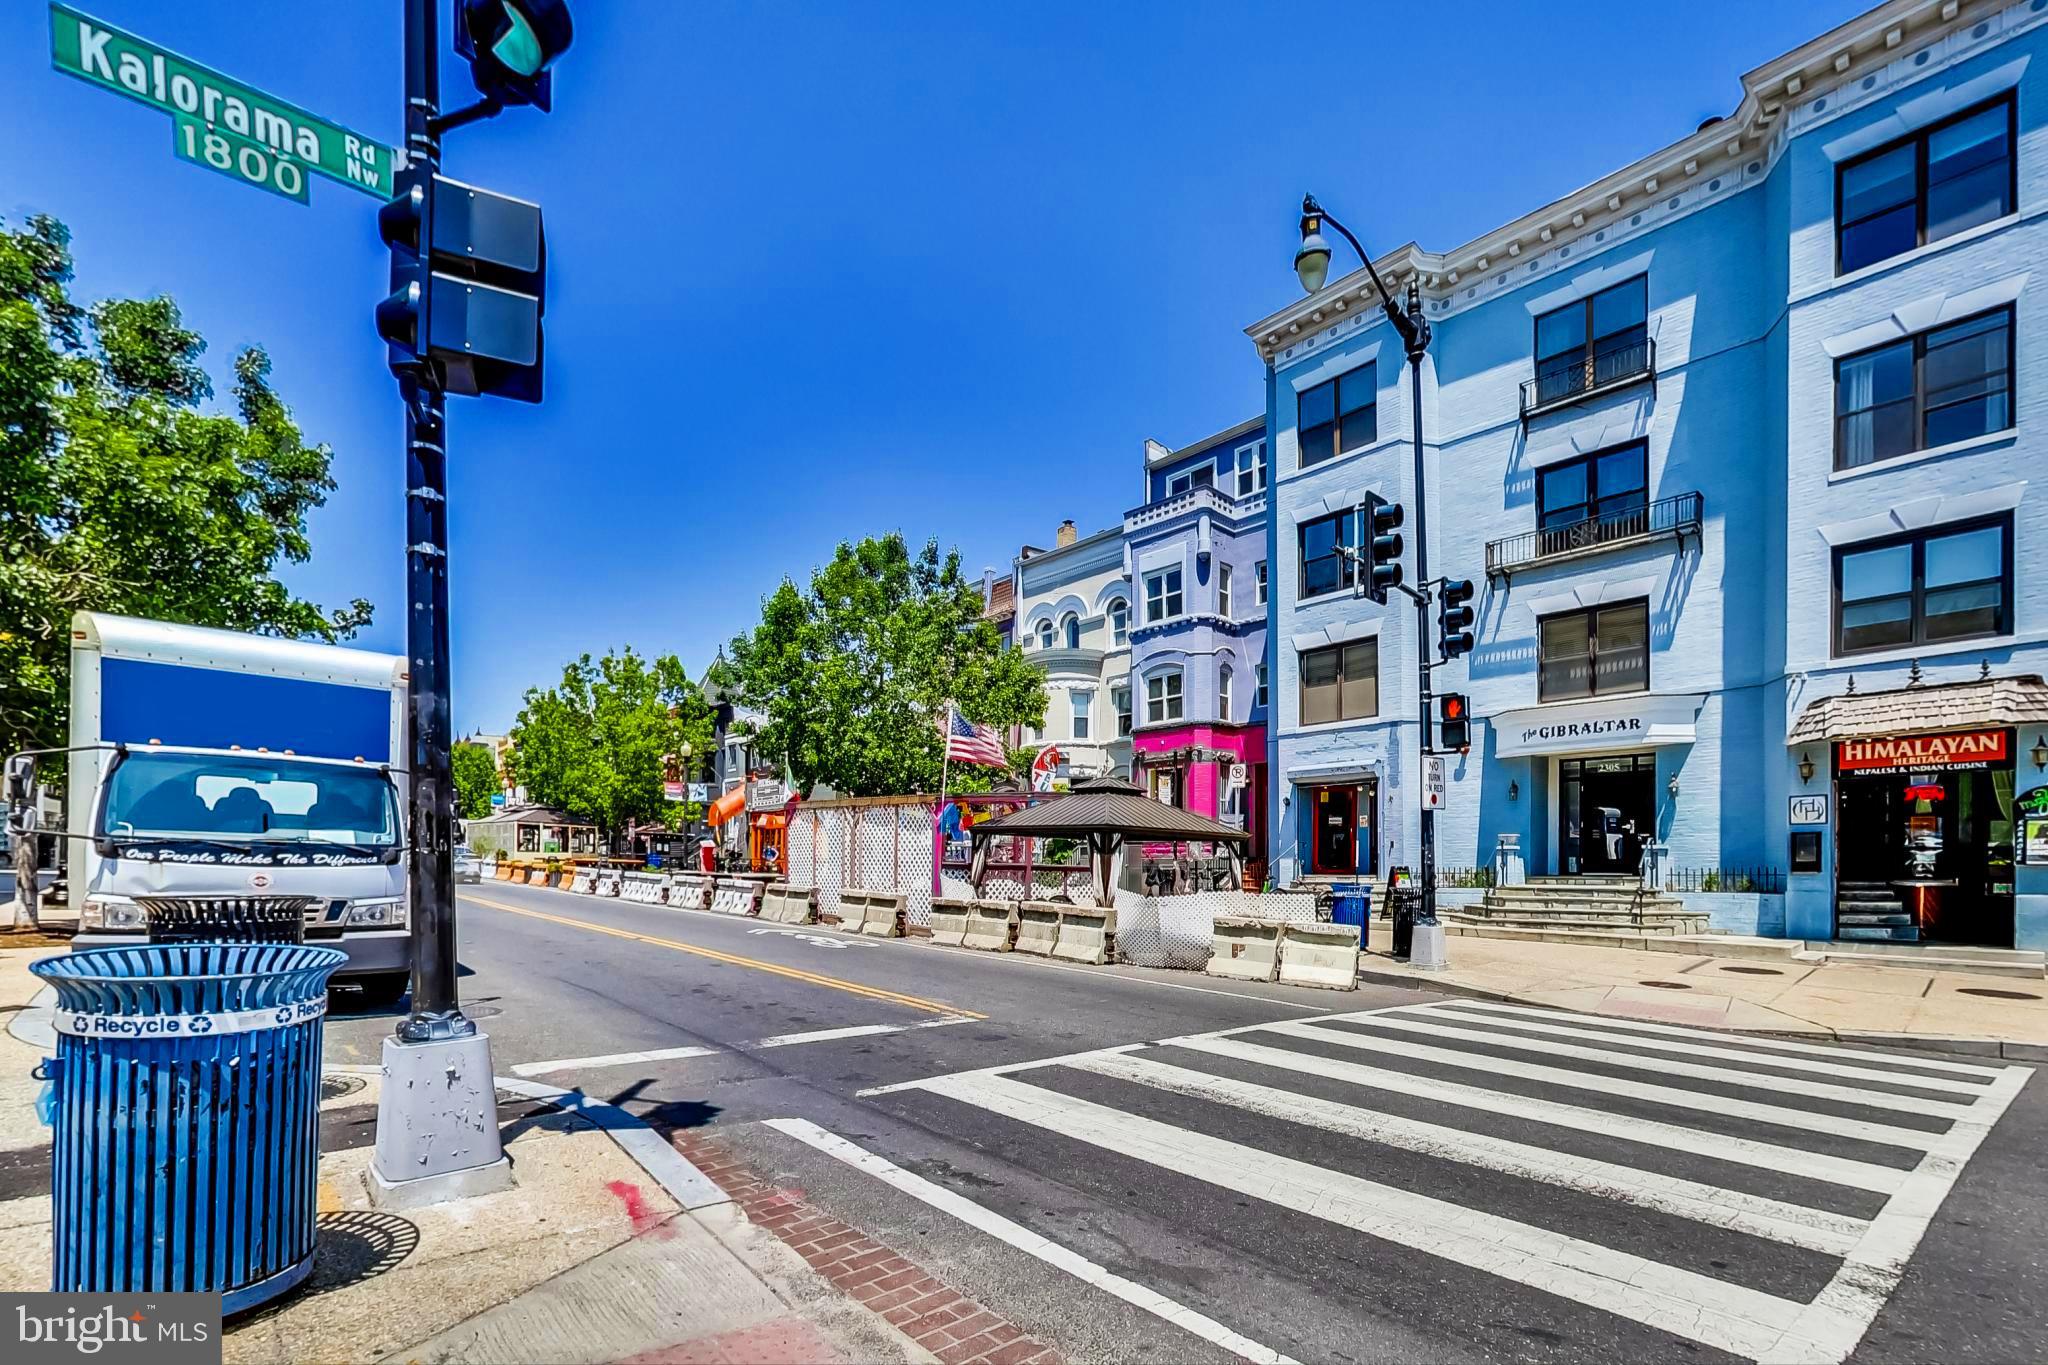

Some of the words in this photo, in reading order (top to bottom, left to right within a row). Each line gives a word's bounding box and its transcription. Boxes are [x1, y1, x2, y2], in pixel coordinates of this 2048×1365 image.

[79, 21, 320, 165] Kalorama
[345, 134, 376, 166] Rd
[183, 125, 302, 195] 1800
[1521, 728, 1537, 742] The
[1539, 718, 1641, 740] GIBRALTAR
[1845, 733, 1999, 761] HIMALAYAN
[1429, 761, 1439, 771] NO
[1854, 767, 1897, 776] NEPALESE
[1910, 764, 1945, 773] INDIAN
[1947, 761, 1988, 771] CUISINE
[1892, 755, 1951, 766] HERITAGE
[1428, 773, 1441, 782] TURN
[1425, 784, 1433, 792] ON
[1434, 784, 1444, 793] RED
[126, 848, 155, 860] Our
[158, 849, 215, 864] People
[221, 852, 272, 865] Make
[277, 853, 308, 865] The
[94, 1016, 180, 1037] Recycle
